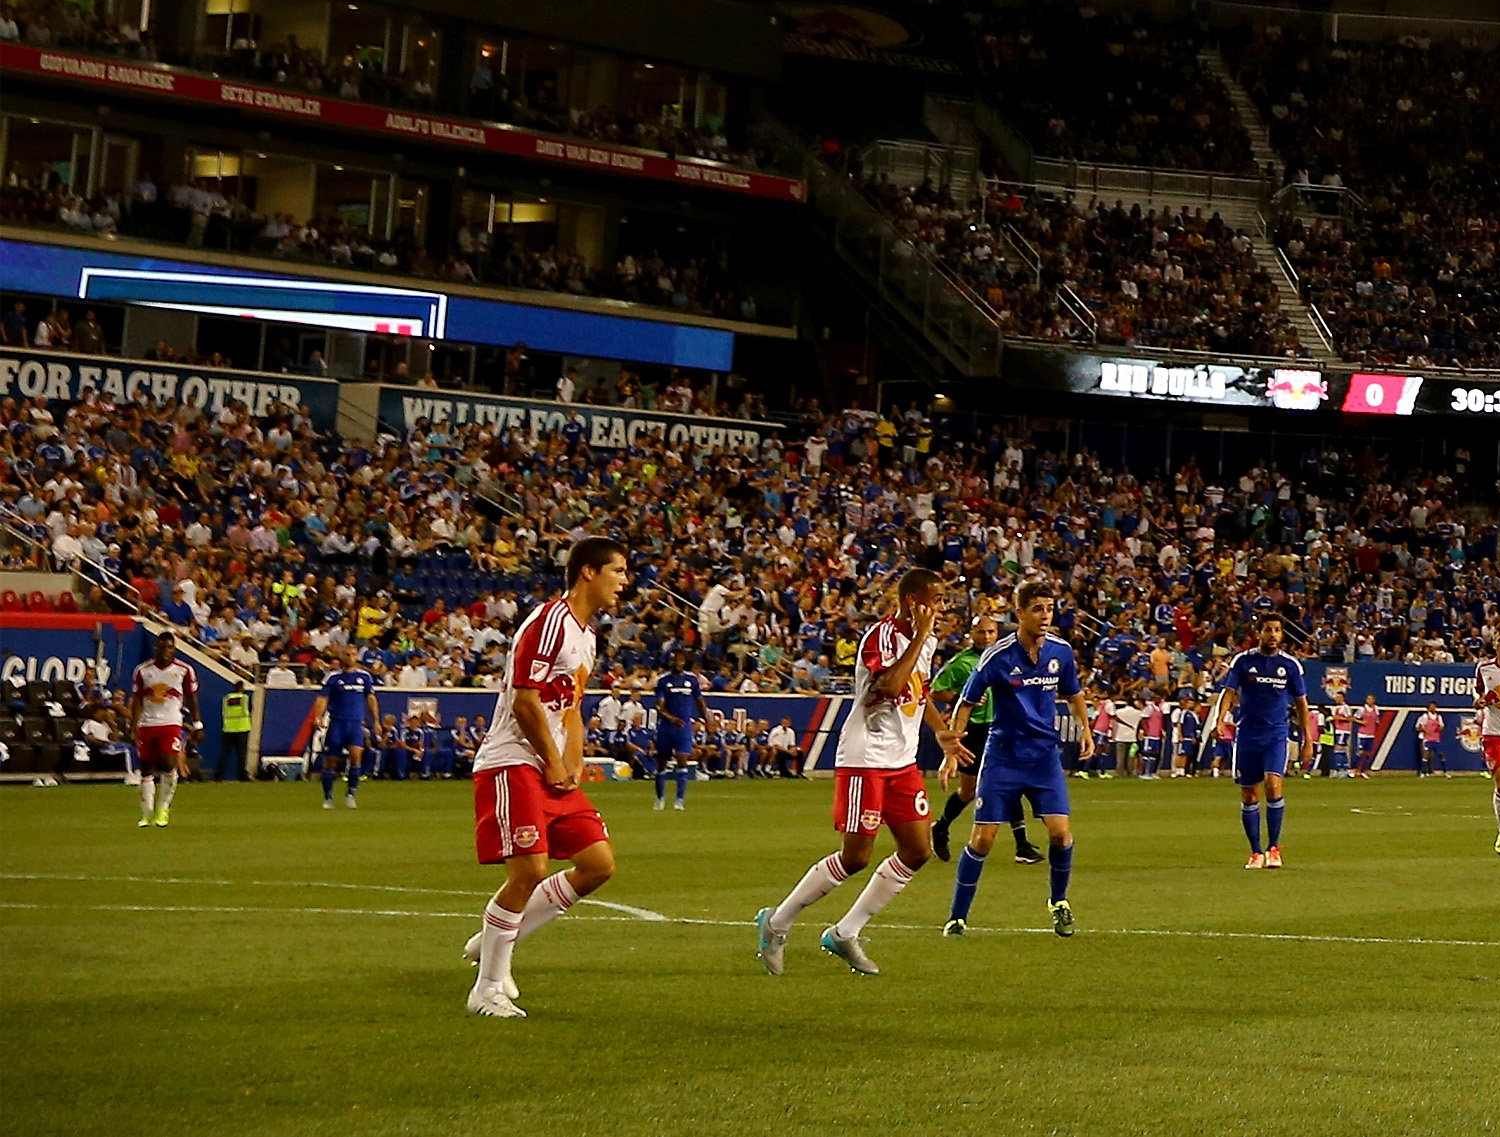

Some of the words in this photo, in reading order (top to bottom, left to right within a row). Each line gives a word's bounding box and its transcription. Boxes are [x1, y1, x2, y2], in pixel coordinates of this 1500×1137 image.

[0, 359, 71, 400] FOR
[78, 365, 178, 408] EACH
[181, 376, 301, 418] OTHER
[1100, 362, 1148, 393] RED
[1151, 366, 1226, 399] BULLS
[1364, 383, 1385, 406] 0
[402, 397, 453, 430] WE
[589, 415, 667, 449] EACH
[669, 423, 760, 457] OTHER
[1384, 675, 1416, 694] THIS
[1420, 676, 1436, 695] IS
[1440, 677, 1478, 695] FIGH
[914, 789, 930, 817] 6
